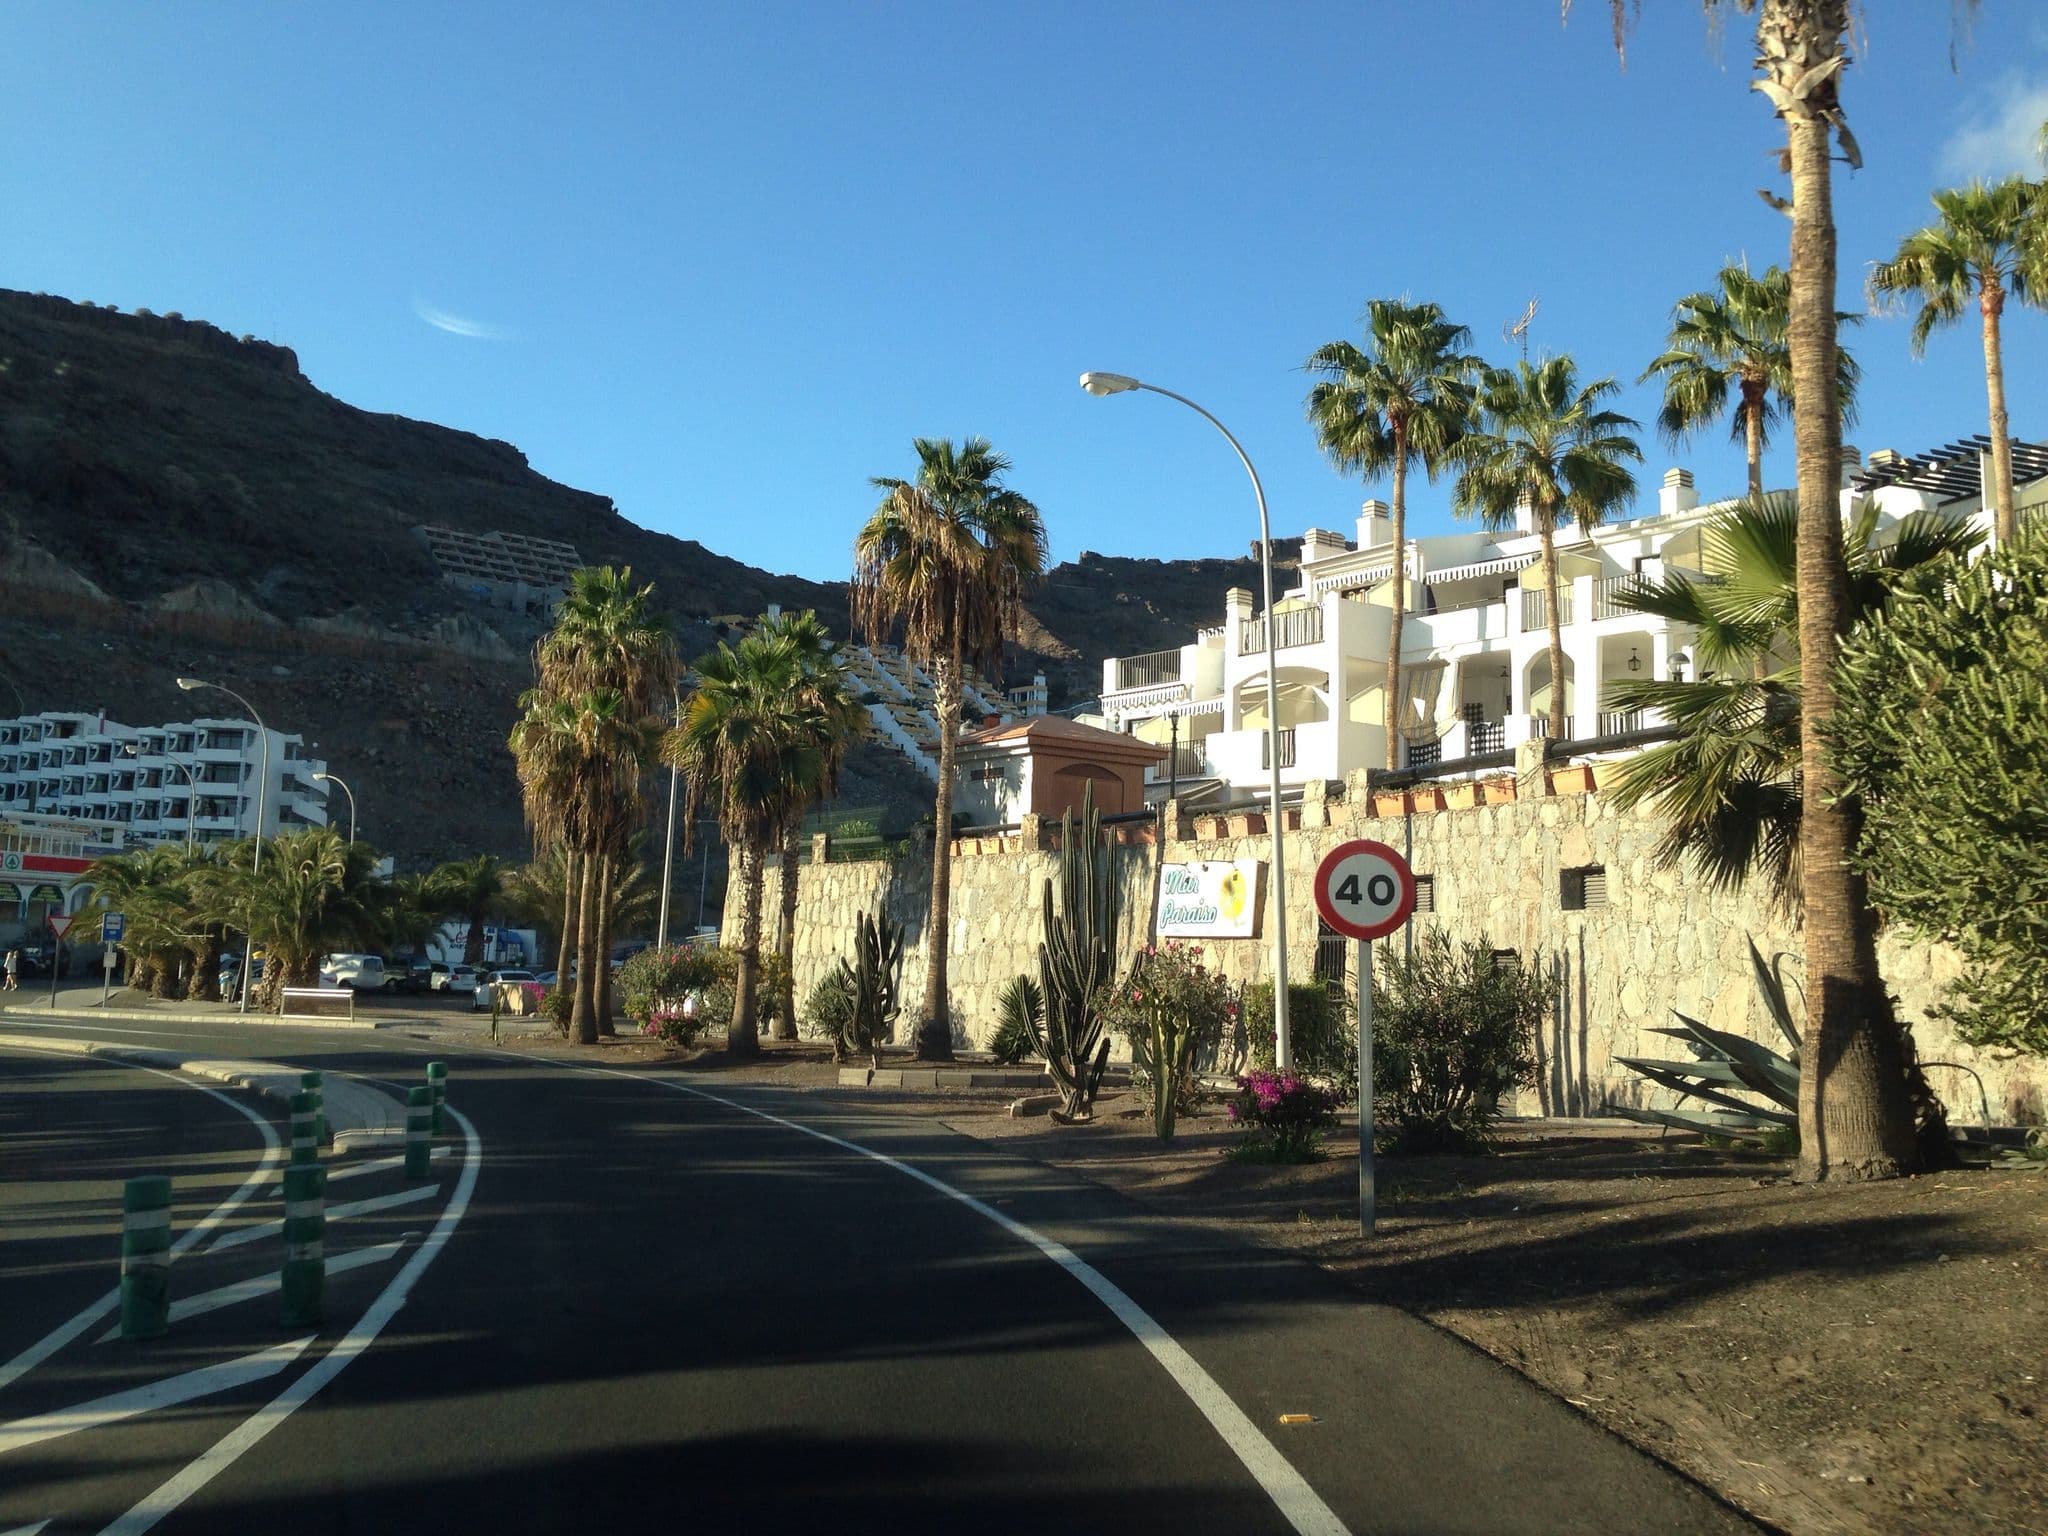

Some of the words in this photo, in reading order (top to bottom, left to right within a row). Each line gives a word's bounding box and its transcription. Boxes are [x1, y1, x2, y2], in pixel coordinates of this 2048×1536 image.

[1165, 869, 1200, 895] Mar
[1335, 874, 1395, 906] 40
[1160, 898, 1218, 930] Paraiso
